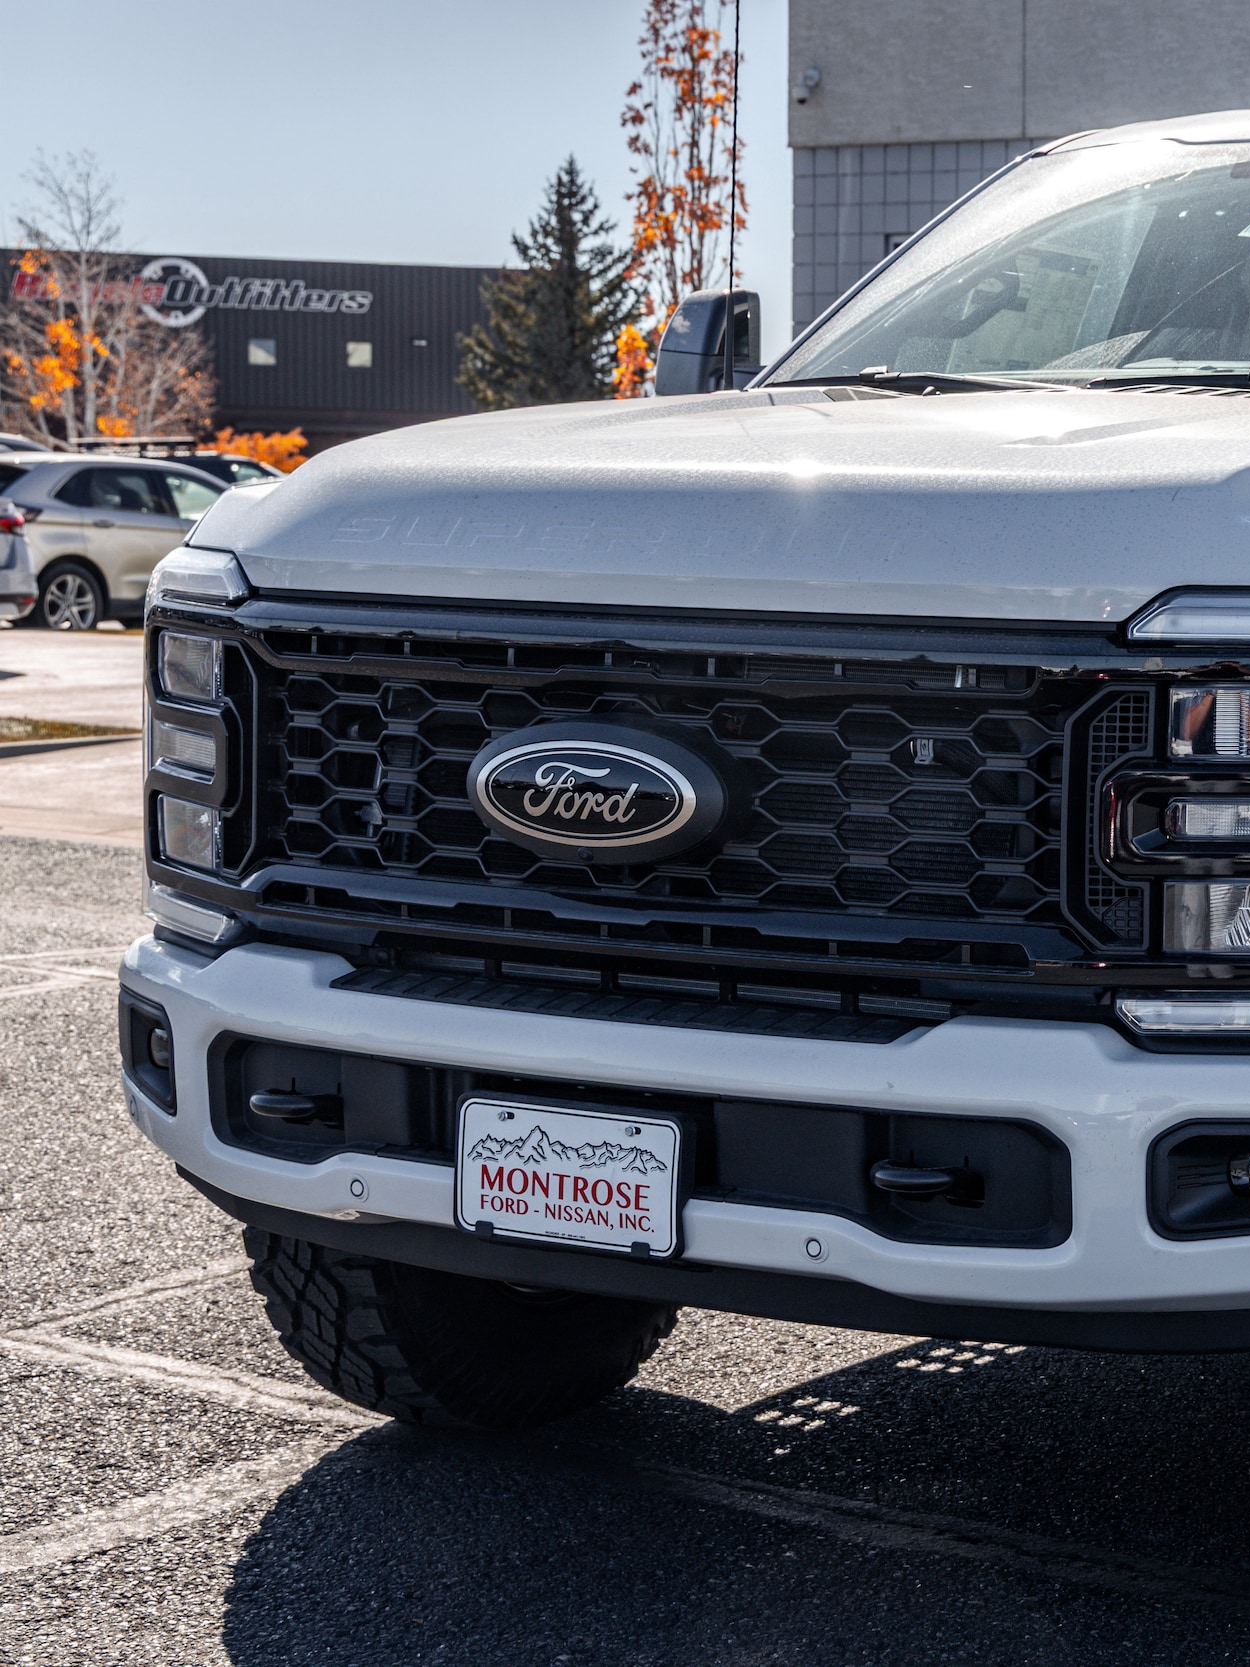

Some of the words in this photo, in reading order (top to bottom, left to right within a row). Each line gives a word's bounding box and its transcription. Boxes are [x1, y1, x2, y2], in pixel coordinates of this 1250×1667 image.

[164, 275, 373, 314] Outfitters
[523, 761, 640, 823] Ford
[480, 1164, 650, 1211] MONTROSE
[480, 1194, 529, 1215] FORD
[544, 1203, 614, 1231] NISSAN,
[619, 1212, 655, 1233] INC.
